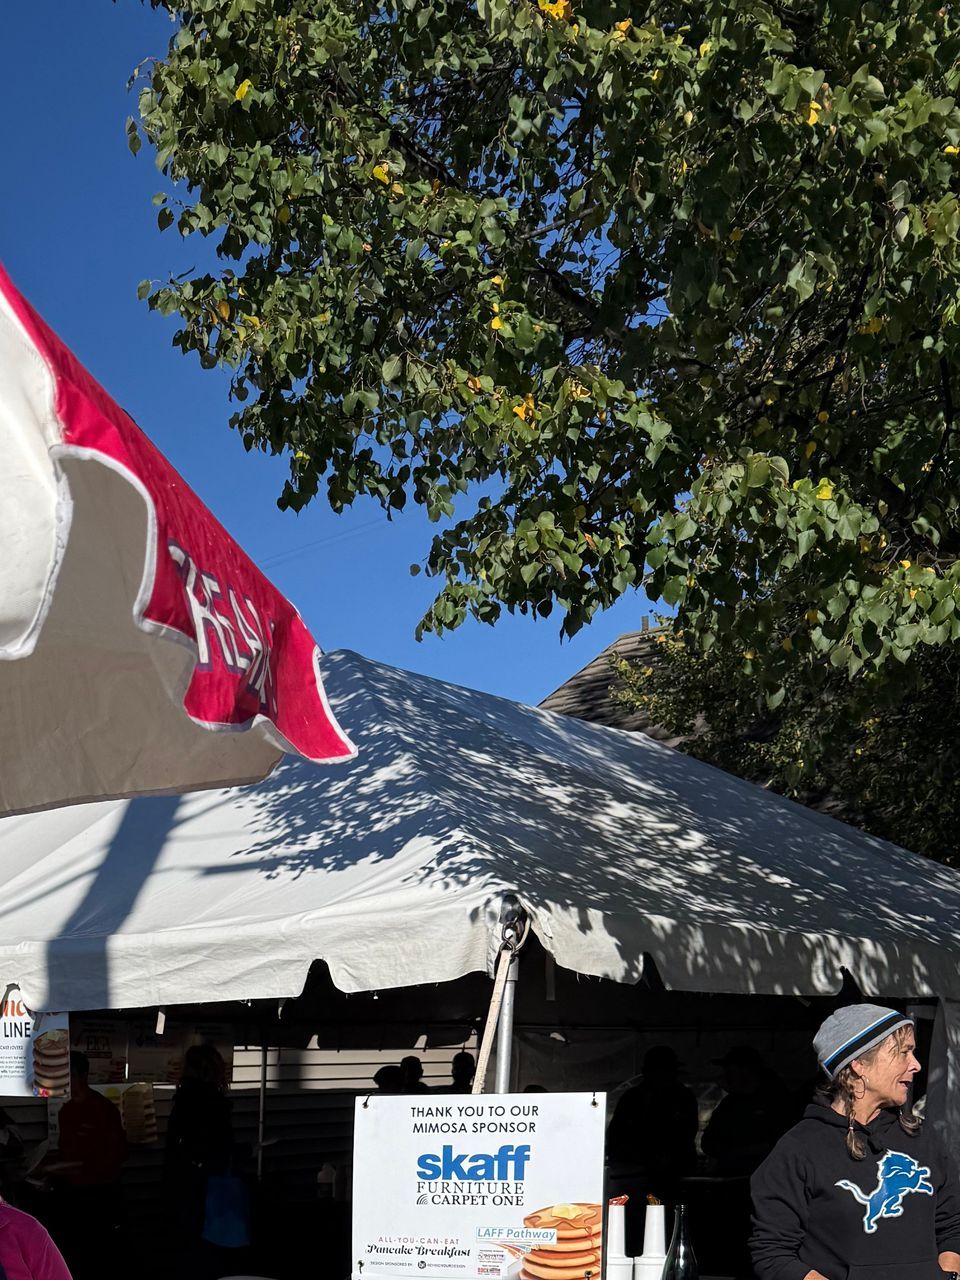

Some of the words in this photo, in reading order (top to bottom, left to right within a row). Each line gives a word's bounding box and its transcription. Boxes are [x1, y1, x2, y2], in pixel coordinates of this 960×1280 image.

[3, 1022, 31, 1038] LINE
[411, 1106, 453, 1118] THANK
[457, 1105, 484, 1117] YOU
[488, 1105, 506, 1117] TO
[510, 1105, 539, 1117] OUR
[412, 1122, 468, 1134] MIMOSA
[471, 1121, 536, 1133] SPONSOR
[416, 1144, 531, 1181] skaff
[416, 1181, 525, 1195] FURNITURE
[431, 1194, 488, 1206] CARPET
[492, 1194, 525, 1207] ONE
[378, 1236, 460, 1246] ALL-YOU-CAN-EAT
[477, 1228, 504, 1238] LAFF
[506, 1229, 556, 1241] Pathway
[366, 1244, 414, 1256] Pancake
[415, 1245, 471, 1259] Breakfast
